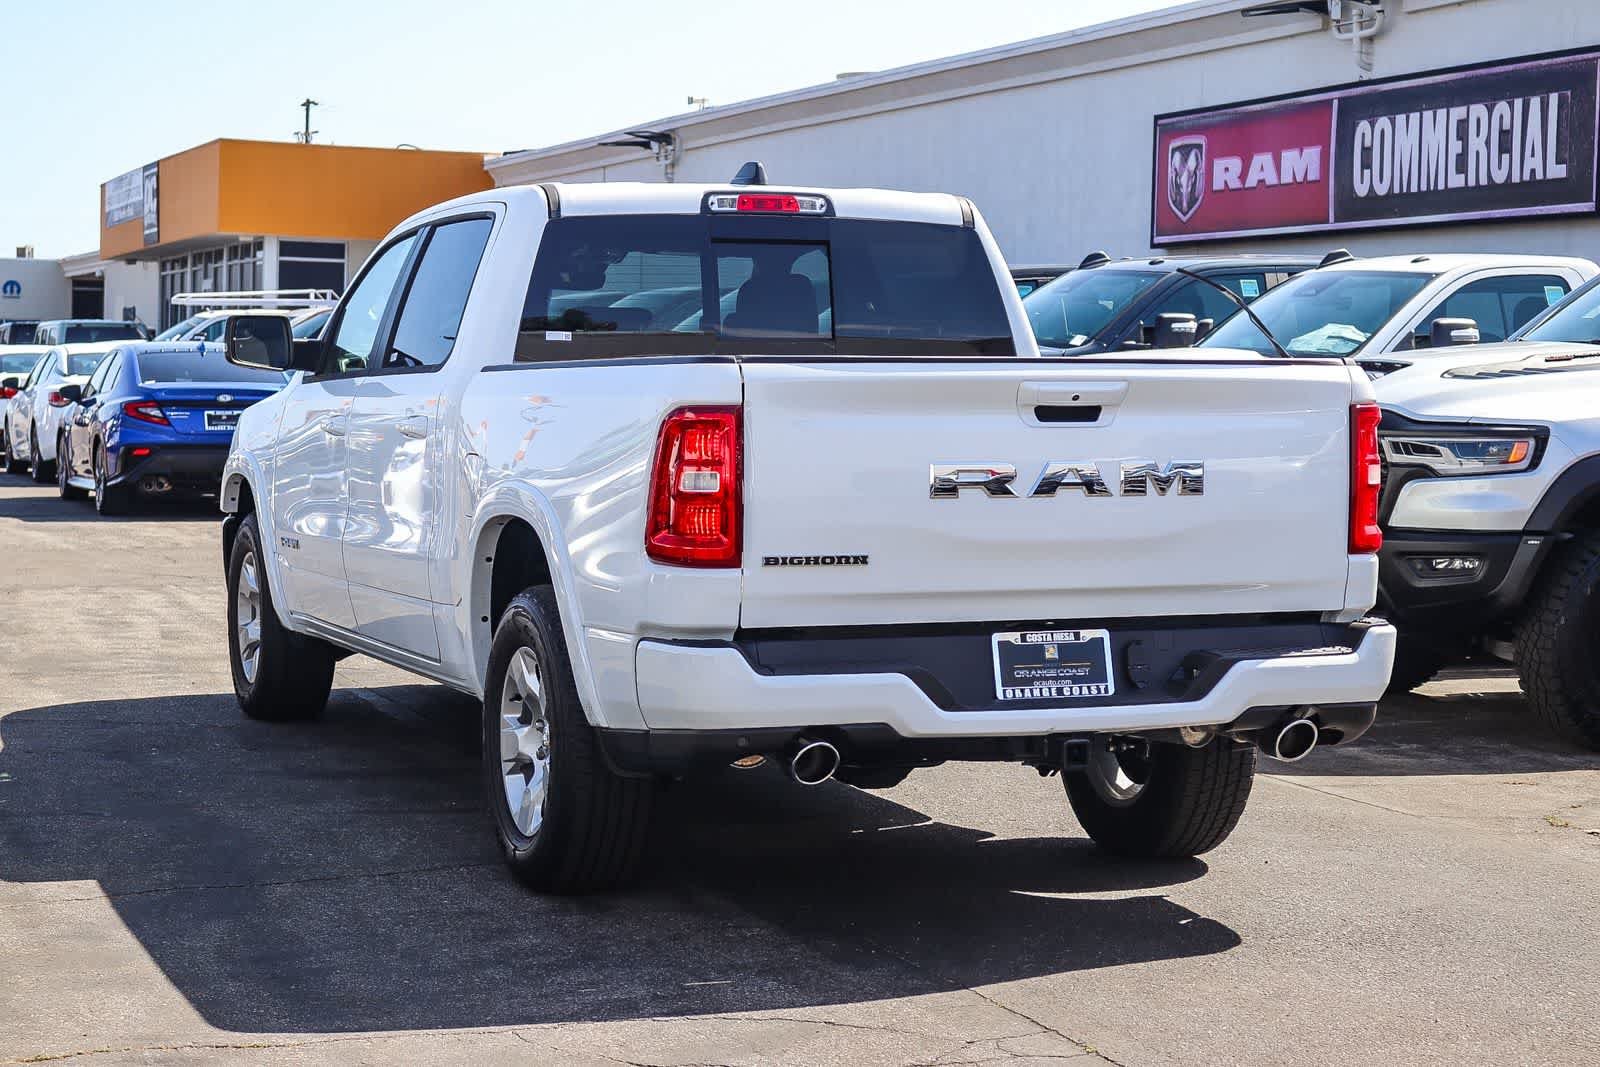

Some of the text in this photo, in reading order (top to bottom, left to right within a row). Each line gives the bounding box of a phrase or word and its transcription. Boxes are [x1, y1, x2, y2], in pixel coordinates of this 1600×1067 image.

[1212, 92, 1567, 198] RAM COMMERCIAL
[929, 459, 1205, 499] RAM
[762, 554, 869, 567] BIGHORN
[1026, 632, 1075, 643] COSTA MESA
[1014, 667, 1090, 678] ORANGE COAST
[1033, 679, 1073, 687] ocauto.com
[1006, 685, 1107, 698] ORANGE COAST
